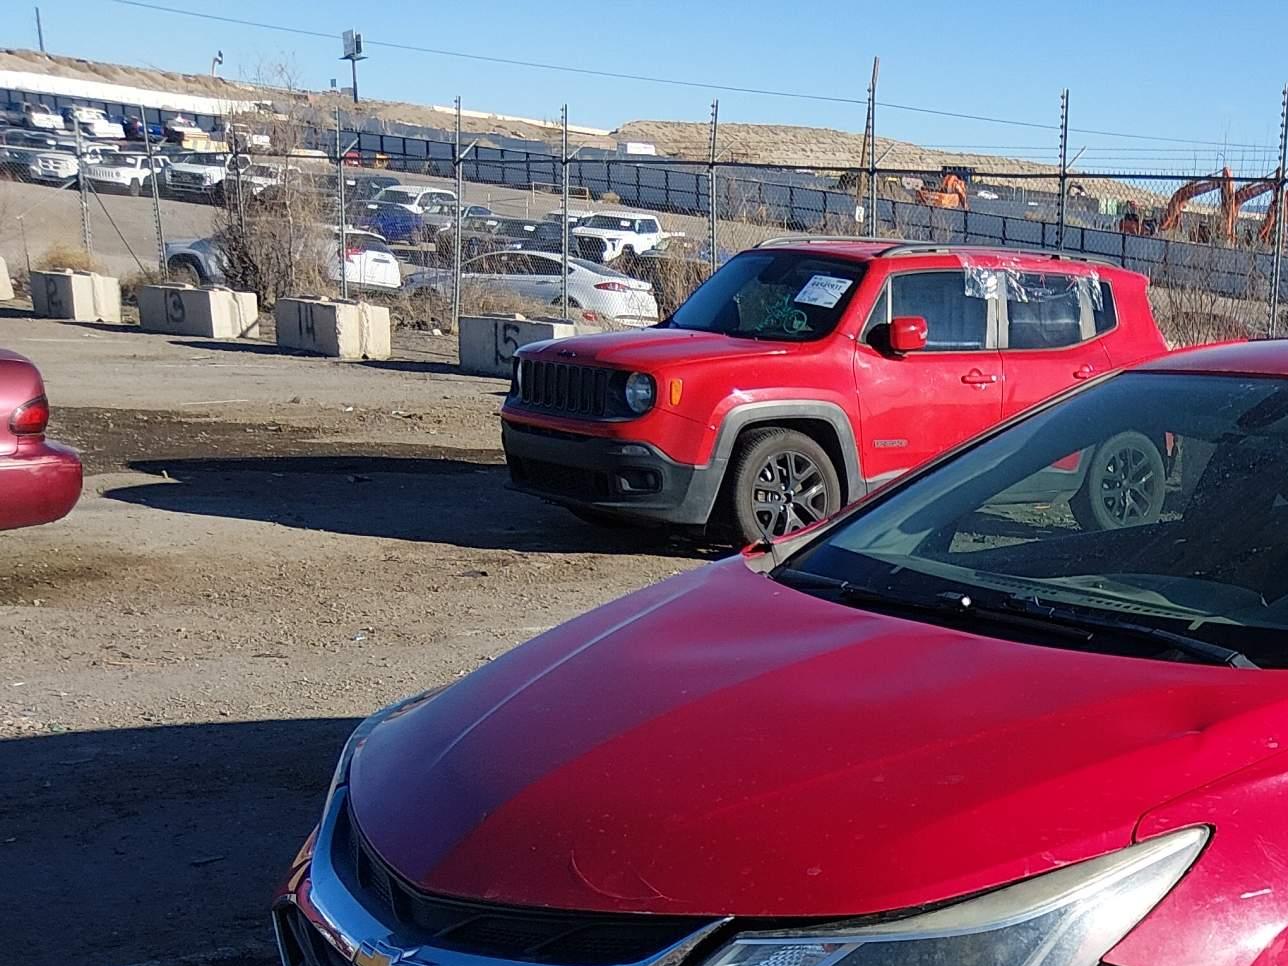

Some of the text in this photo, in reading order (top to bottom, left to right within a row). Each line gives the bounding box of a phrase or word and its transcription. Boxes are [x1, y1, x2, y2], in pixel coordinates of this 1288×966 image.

[164, 289, 185, 324] 13
[298, 302, 316, 343] 14
[494, 321, 520, 367] 15
